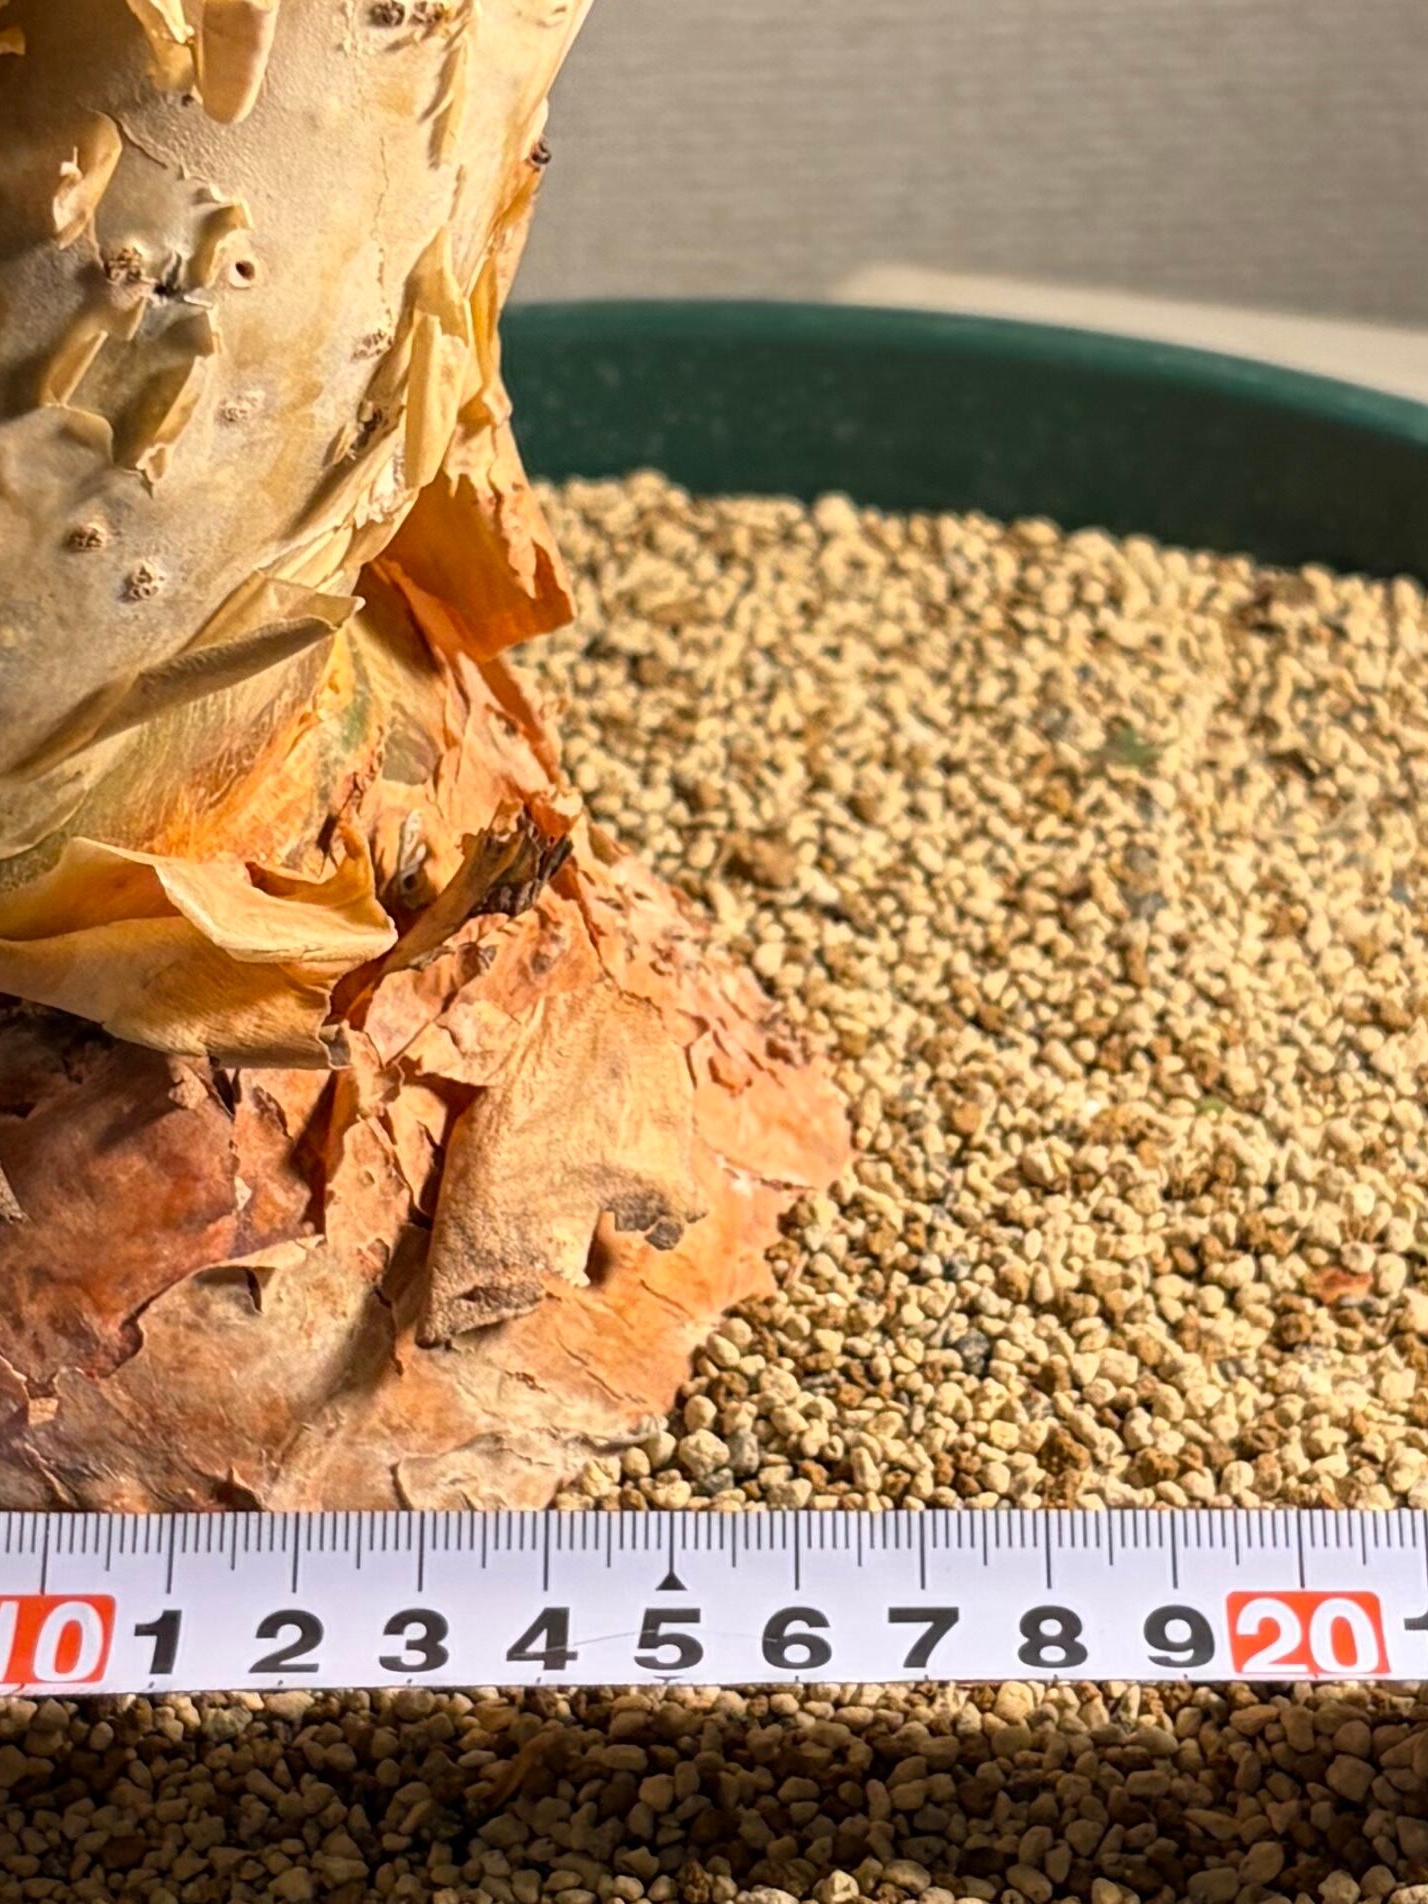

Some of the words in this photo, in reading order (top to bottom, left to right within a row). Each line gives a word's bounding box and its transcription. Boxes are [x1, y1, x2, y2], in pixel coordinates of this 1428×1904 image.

[133, 1609, 183, 1675] 1
[248, 1608, 325, 1674] 2
[378, 1607, 450, 1673] 3
[505, 1606, 579, 1671] 4
[633, 1607, 704, 1671] 5
[761, 1606, 833, 1671] 6
[887, 1606, 960, 1669] 7
[1017, 1604, 1089, 1669] 8
[1143, 1604, 1216, 1669] 9
[1235, 1597, 1376, 1675] 20
